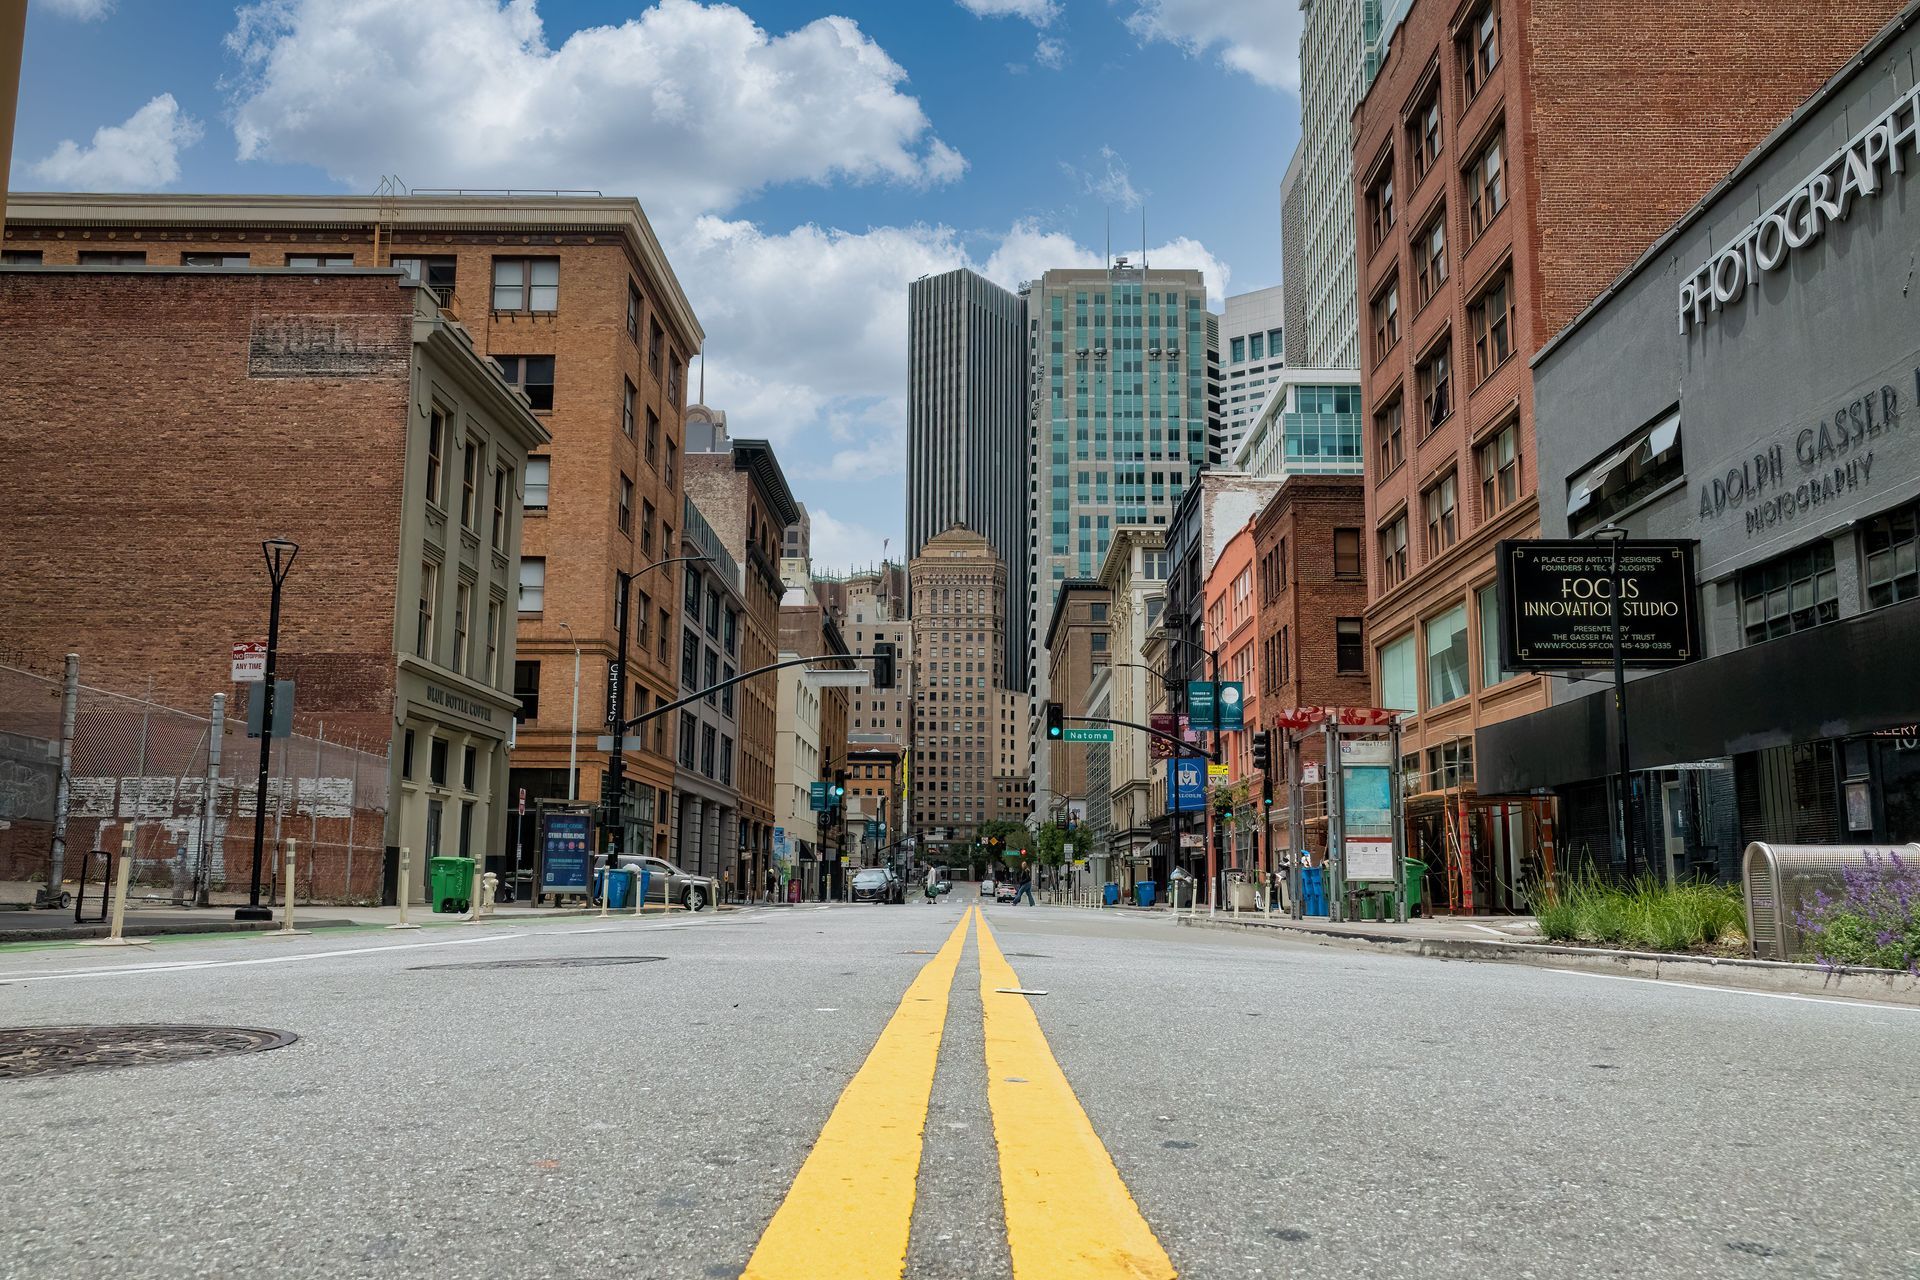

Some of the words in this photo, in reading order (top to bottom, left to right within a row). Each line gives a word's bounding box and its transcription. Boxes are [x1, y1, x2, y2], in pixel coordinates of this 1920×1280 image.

[1700, 444, 1784, 520] ADOLPH
[1796, 384, 1899, 468] GASSER
[1746, 451, 1874, 535] PHOTOGRAPHY
[1593, 564, 1656, 572] TECOLOGISTS
[1623, 601, 1679, 617] STUDIO
[1552, 633, 1567, 641] THE
[1569, 633, 1600, 641] GASSER
[1631, 633, 1656, 641] TRUST
